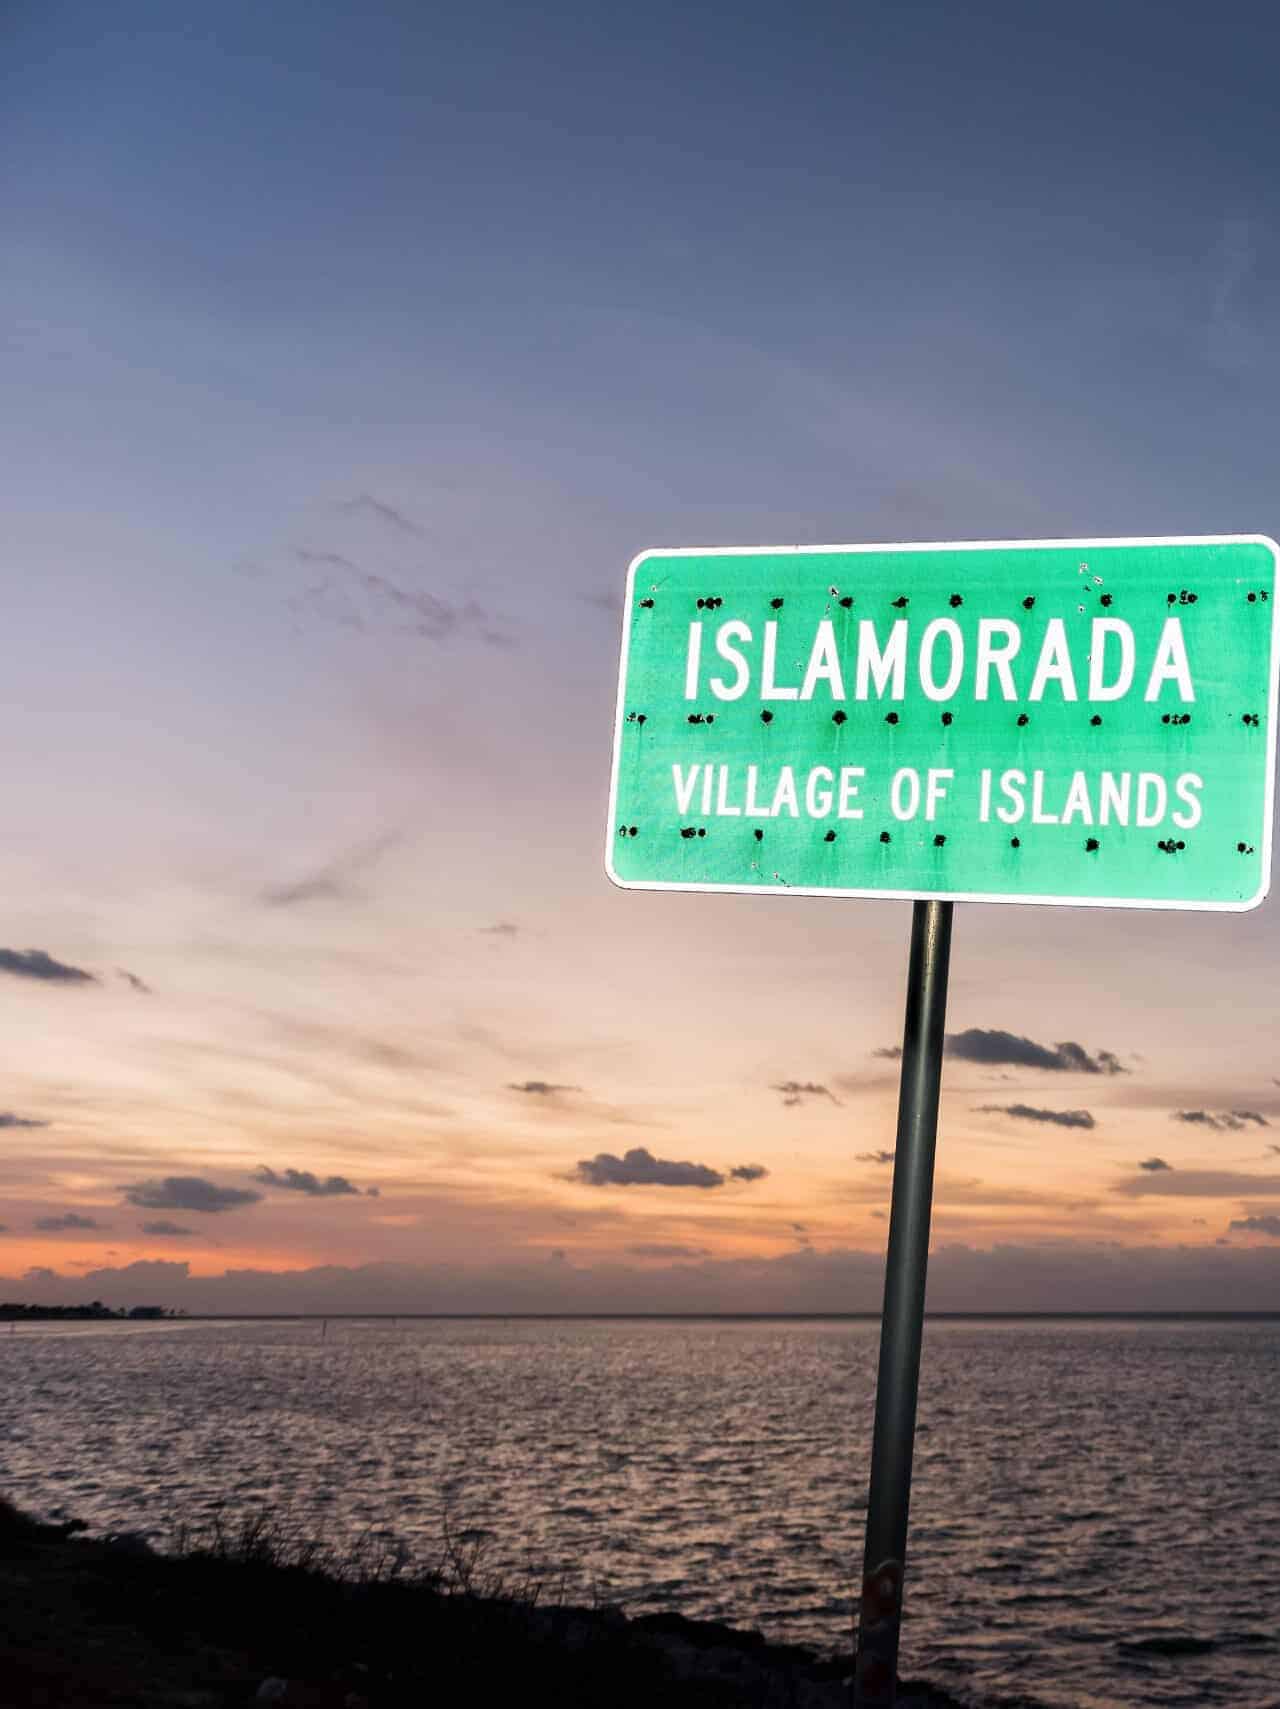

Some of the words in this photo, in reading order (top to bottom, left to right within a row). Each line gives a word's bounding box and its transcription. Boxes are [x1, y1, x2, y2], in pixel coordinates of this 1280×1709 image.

[685, 617, 1196, 702] ISLAMORADA
[672, 764, 865, 819] VILLAGE
[891, 768, 954, 821] OF
[979, 769, 1203, 829] ISLANDS
